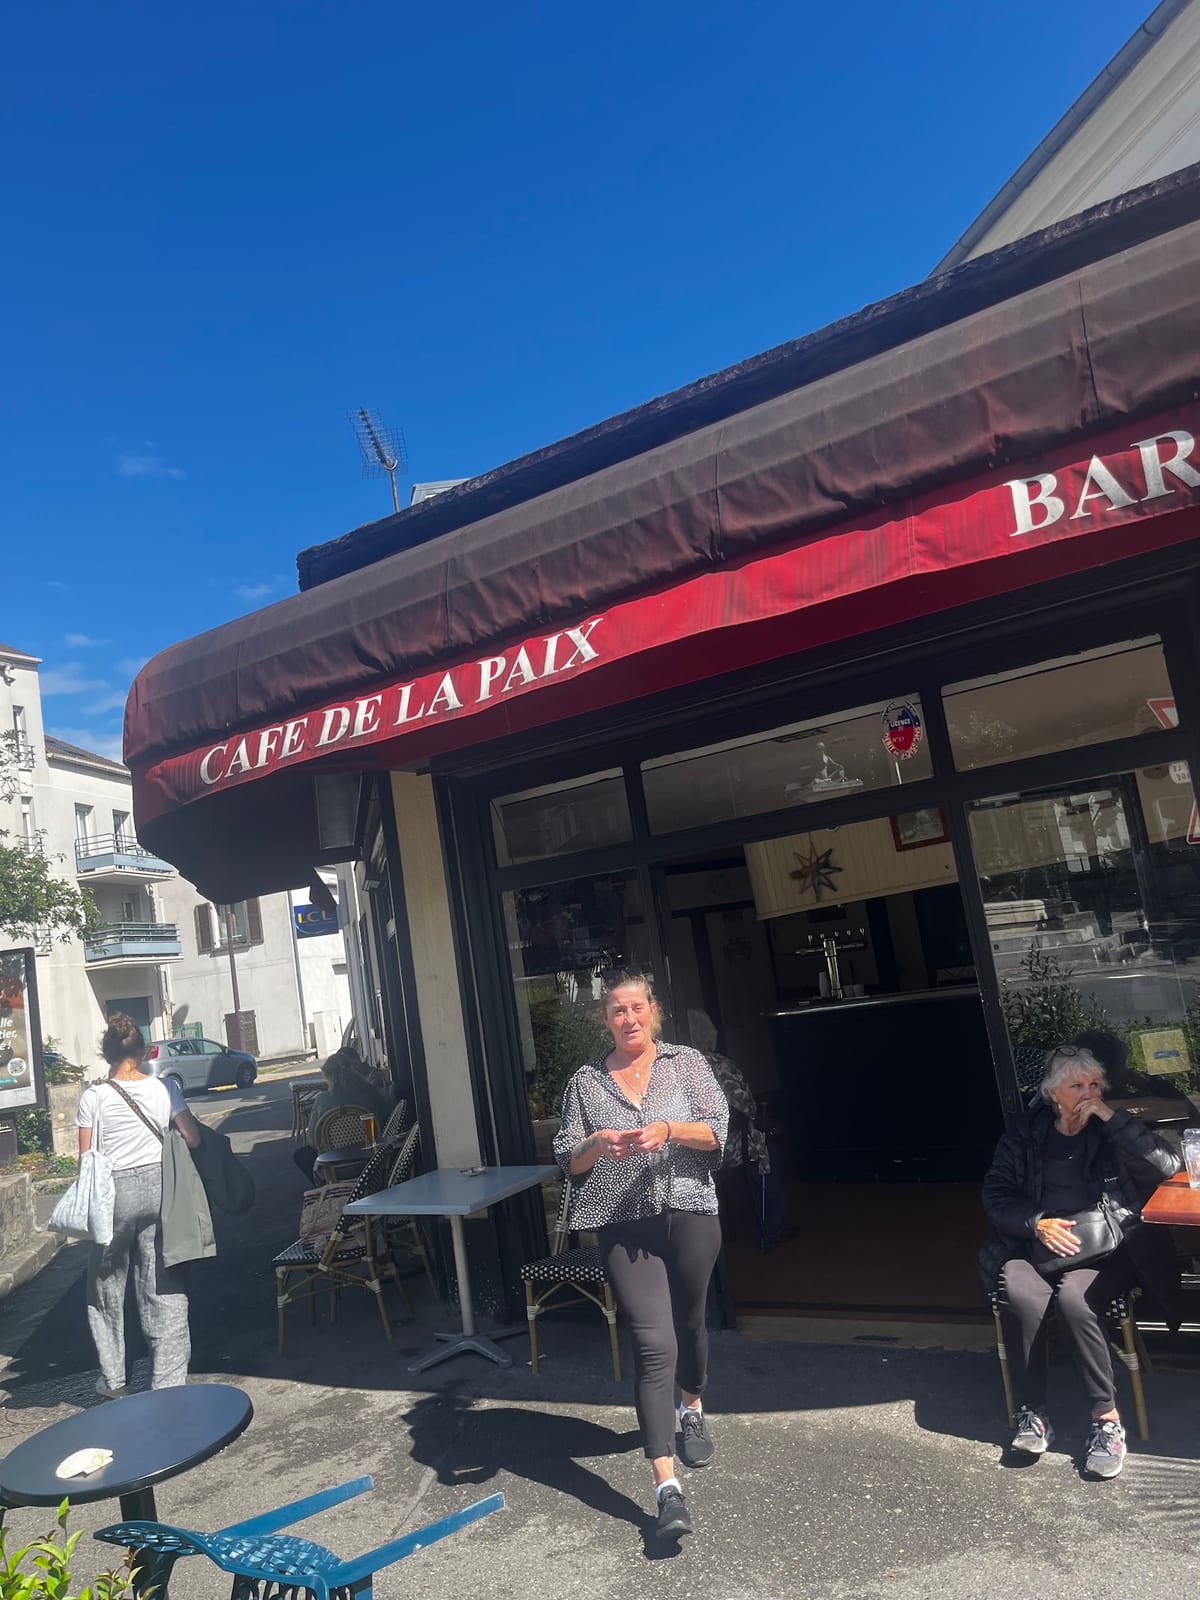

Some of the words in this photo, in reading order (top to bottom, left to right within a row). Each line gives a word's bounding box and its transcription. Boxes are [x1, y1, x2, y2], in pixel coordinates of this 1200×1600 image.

[1003, 430, 1200, 537] BAR
[200, 718, 309, 786] CAFE
[314, 695, 383, 748] DE
[393, 671, 465, 726] LA
[477, 618, 604, 702] PAIX
